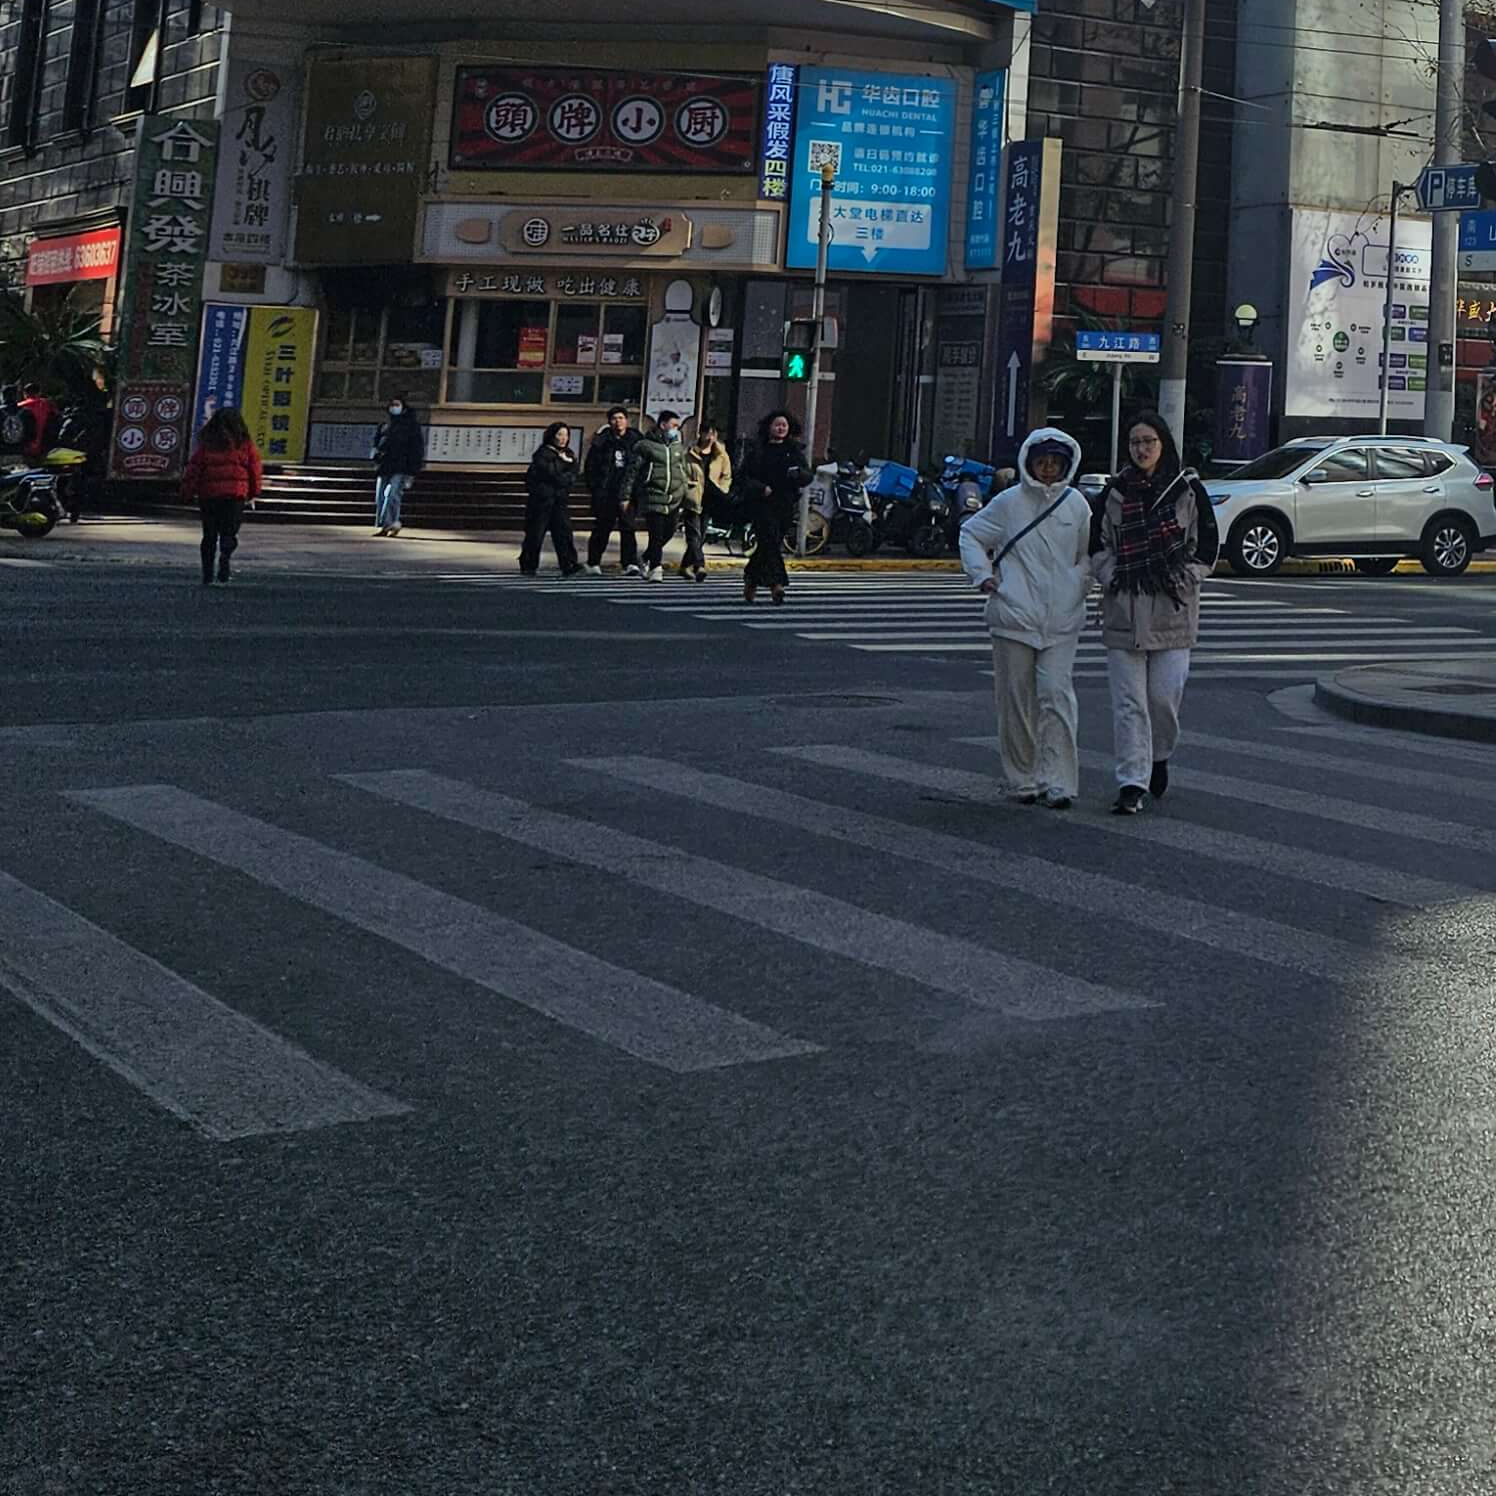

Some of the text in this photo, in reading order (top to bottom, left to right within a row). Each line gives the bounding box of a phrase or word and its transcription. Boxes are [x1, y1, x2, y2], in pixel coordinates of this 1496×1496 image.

[861, 83, 941, 109] 华齿口腔
[762, 63, 794, 198] 唐风采假发四楼
[1007, 156, 1029, 263] 高老九
[1464, 254, 1473, 267] S
[455, 272, 643, 298] 手工现做 吃出健康
